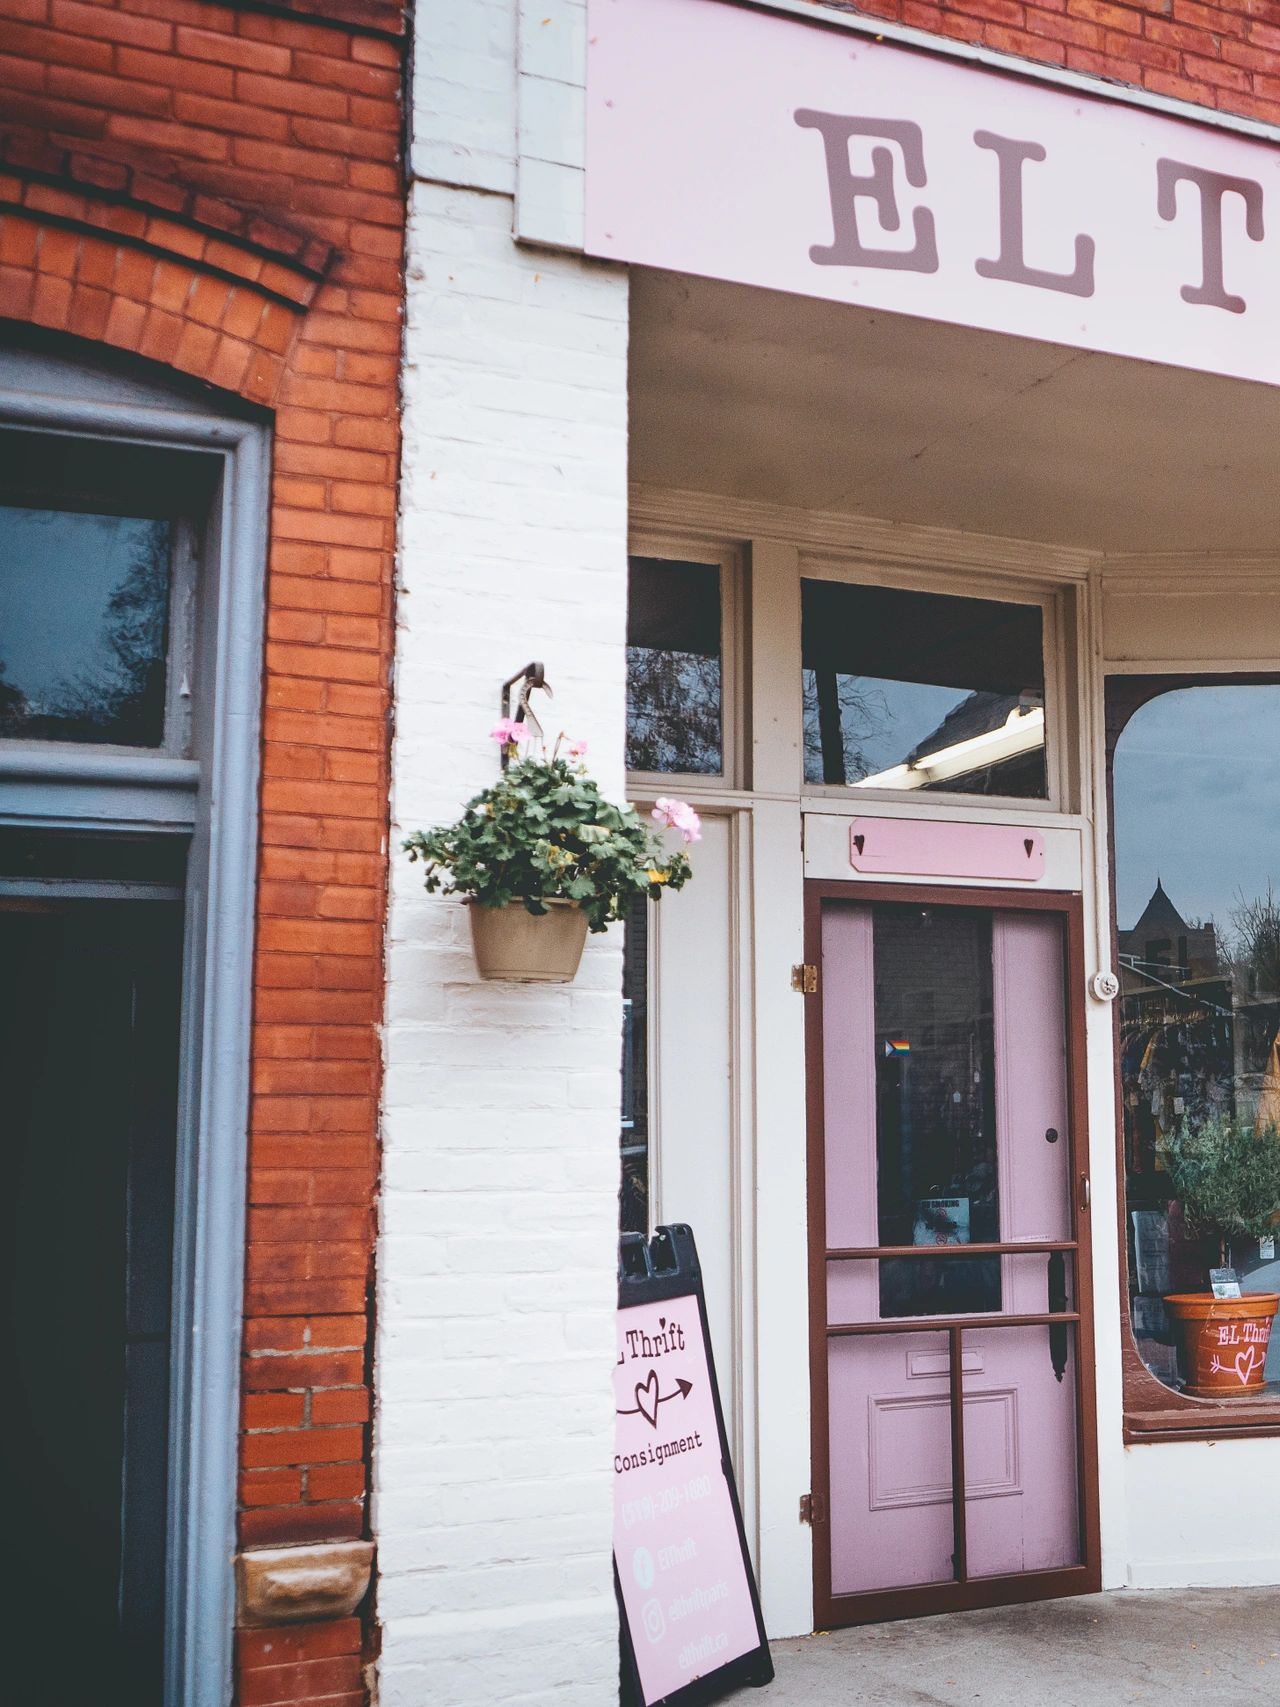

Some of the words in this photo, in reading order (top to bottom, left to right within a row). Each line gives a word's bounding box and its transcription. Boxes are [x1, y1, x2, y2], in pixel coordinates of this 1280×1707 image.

[794, 108, 1095, 299] EL
[625, 1317, 685, 1359] Thrift
[1217, 1325, 1240, 1346] EL
[614, 1431, 703, 1474] Consignment
